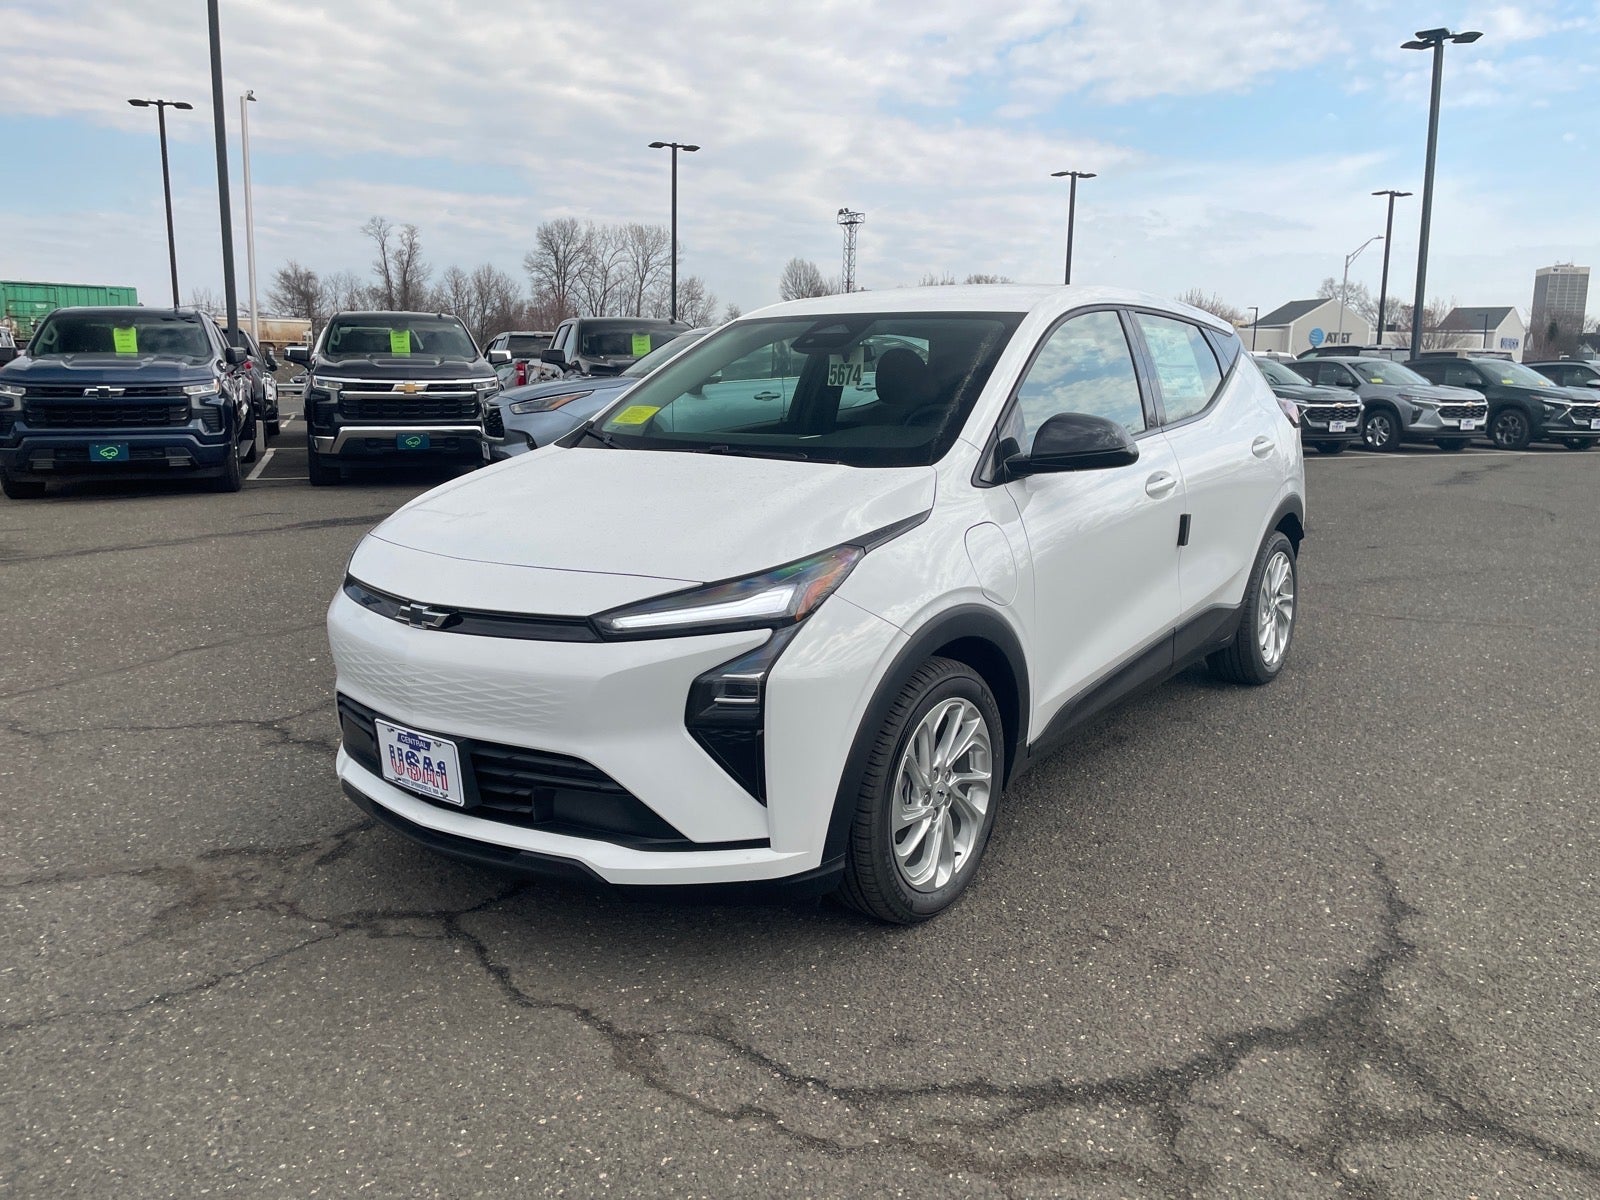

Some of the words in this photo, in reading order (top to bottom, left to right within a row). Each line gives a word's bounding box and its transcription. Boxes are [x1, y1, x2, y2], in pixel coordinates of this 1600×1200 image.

[1325, 332, 1352, 344] AT&T
[829, 363, 862, 385] 5674
[400, 735, 428, 749] CENTRAL
